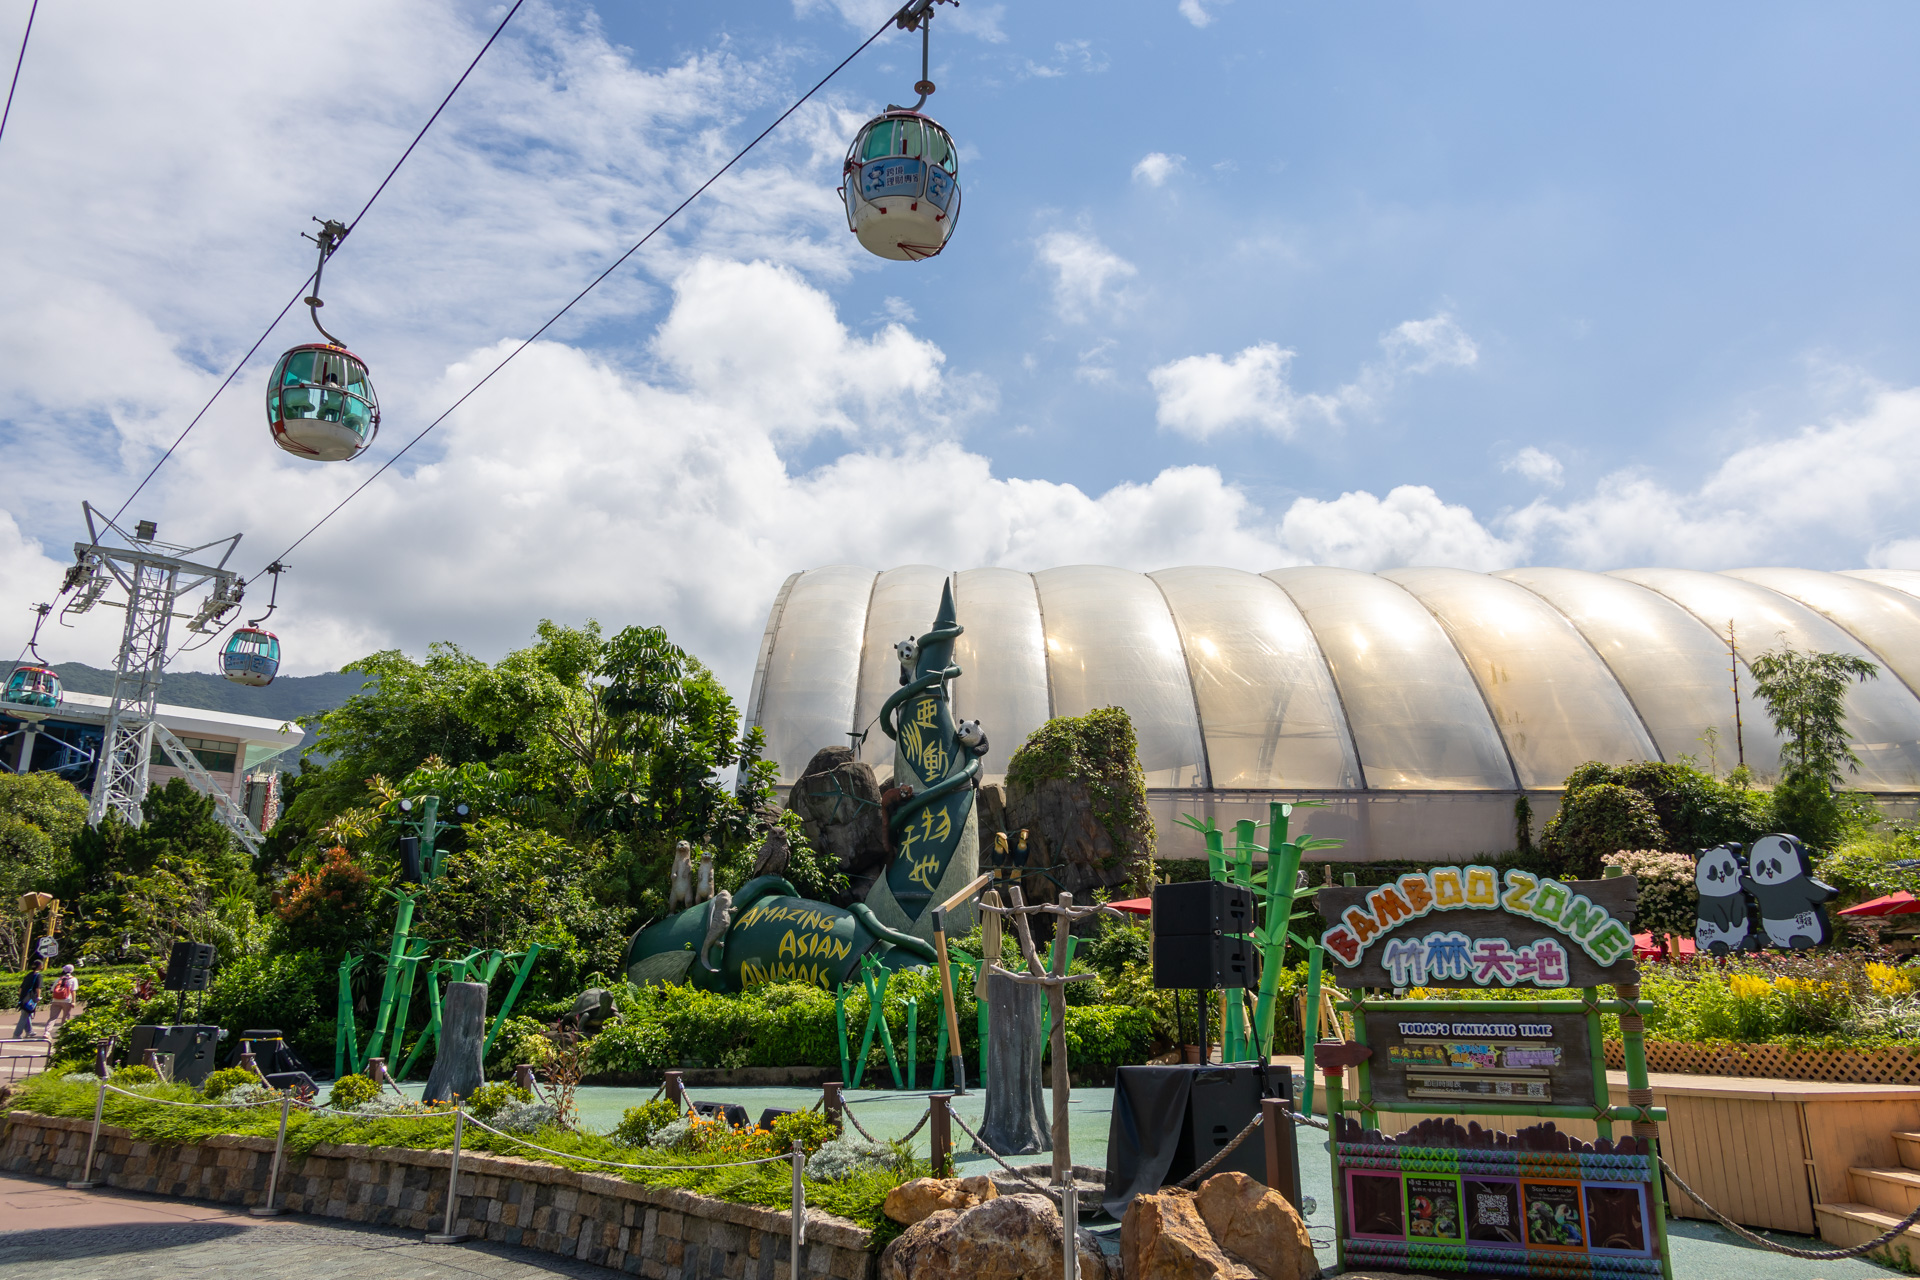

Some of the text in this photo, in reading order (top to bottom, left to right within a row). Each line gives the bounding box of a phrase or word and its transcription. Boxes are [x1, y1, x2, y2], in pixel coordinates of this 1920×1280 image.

[733, 906, 837, 932] AMAZING
[1323, 866, 1635, 967] BAMBOO ZONE
[779, 929, 852, 960] ASIAN
[1384, 933, 1568, 985] 竹林天地
[1399, 1023, 1553, 1037] TODAY'S FANTASTIC TIME
